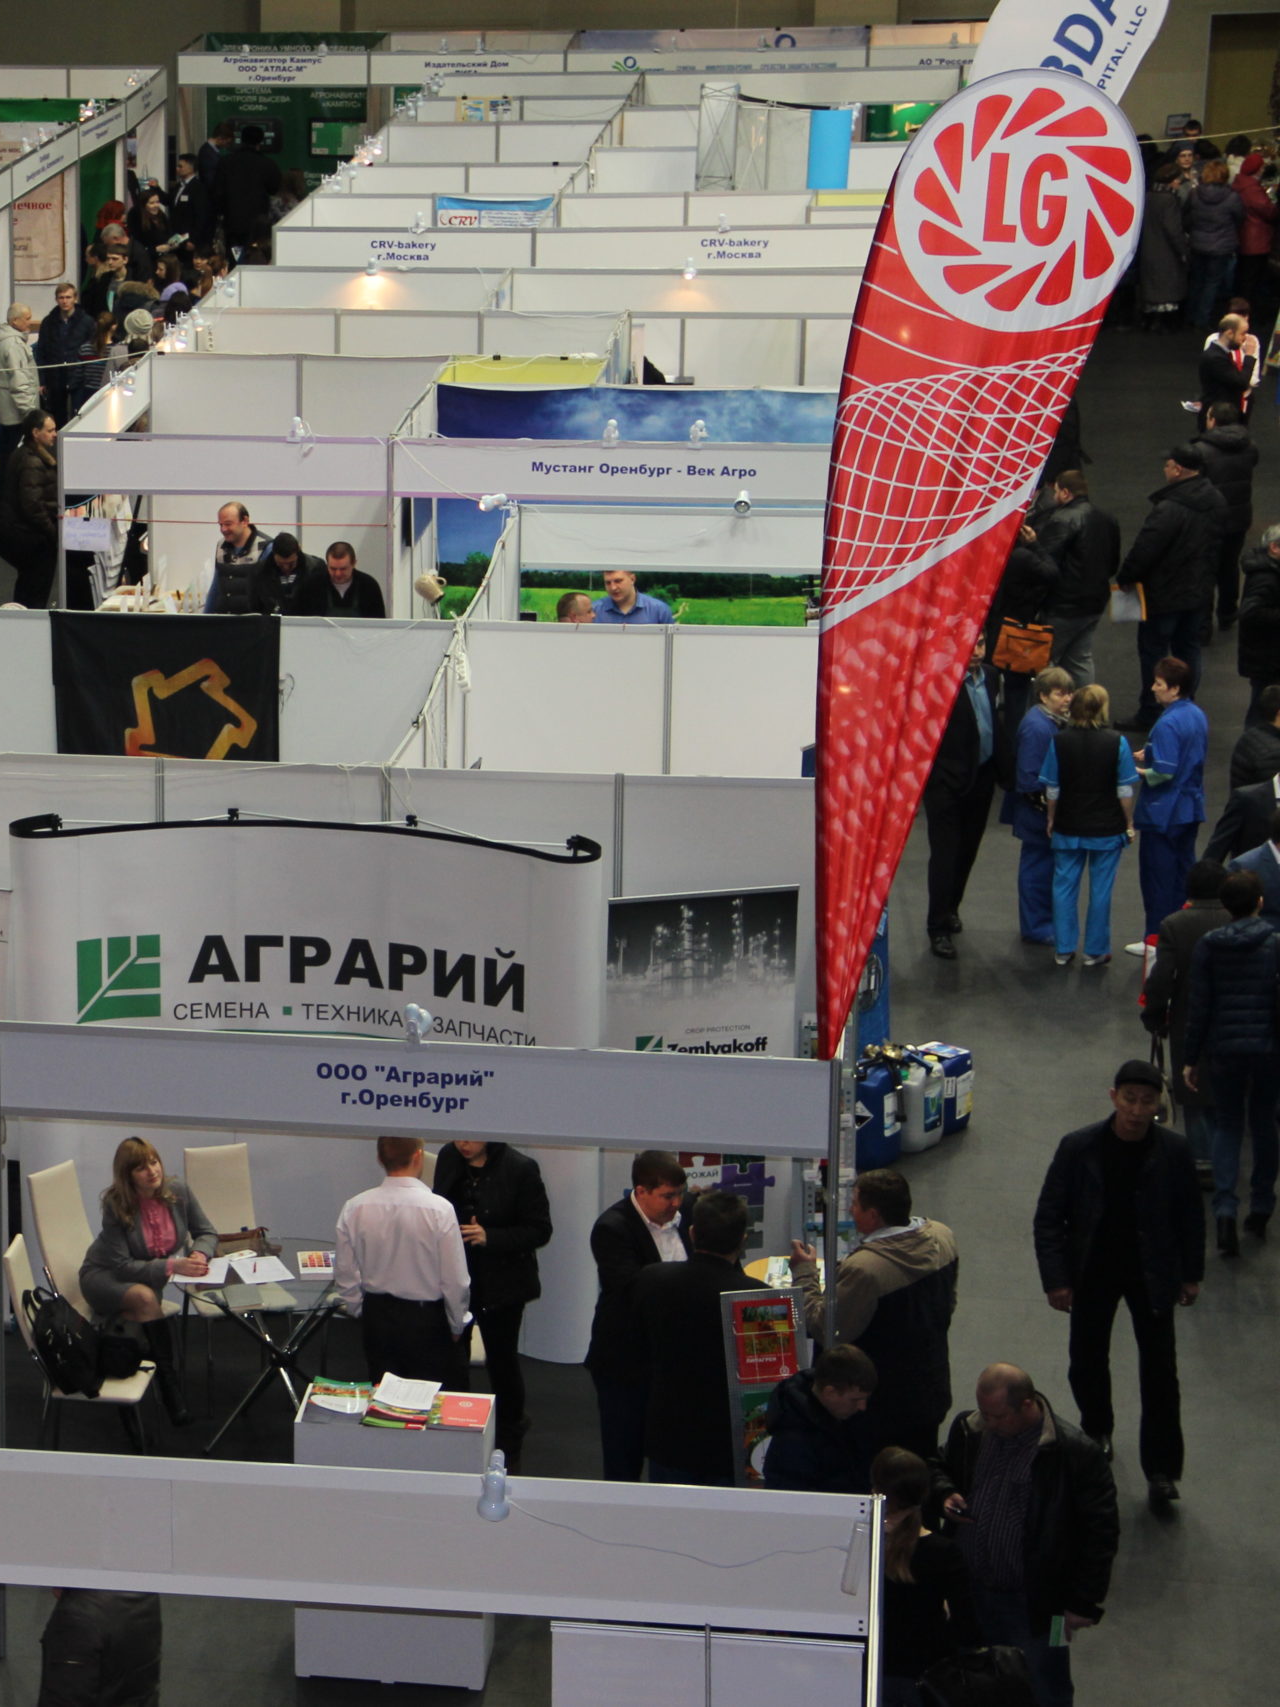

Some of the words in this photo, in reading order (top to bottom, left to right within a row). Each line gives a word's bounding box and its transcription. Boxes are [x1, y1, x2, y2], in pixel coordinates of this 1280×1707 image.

[1096, 41, 1132, 90] PITAL,
[1125, 4, 1148, 36] LLC
[223, 57, 286, 65] Агронавигатор
[290, 57, 323, 66] Кампус
[424, 60, 486, 69] Издательский
[489, 60, 509, 69] Дом
[935, 58, 975, 66] "Россел
[248, 75, 297, 83] г.Оренбург
[310, 91, 368, 100] АГРОНАВИГАТ
[982, 152, 1069, 247] LG
[13, 202, 53, 211] ечное
[447, 214, 479, 227] CRV
[370, 240, 437, 252] CRV-bakery
[700, 238, 770, 250] CRV-bakery
[376, 252, 430, 261] г.Москва
[707, 251, 762, 260] г.Москва
[531, 461, 595, 475] Мустанг
[598, 462, 673, 478] Оренбург
[686, 465, 715, 476] Век
[720, 466, 757, 479] Агро
[188, 935, 525, 1013] АГРАРИЙ
[173, 1002, 270, 1021] СЕМЕНА
[301, 1003, 403, 1028] ТЕХНИКА
[431, 1017, 536, 1047] ЗАПЧАСТИ
[706, 1024, 751, 1033] PROTECTION
[316, 1063, 367, 1081] ООО
[375, 1065, 495, 1089] "Аграрий"
[340, 1089, 469, 1113] г.Оренбург
[685, 1169, 719, 1179] РОЖАЙ
